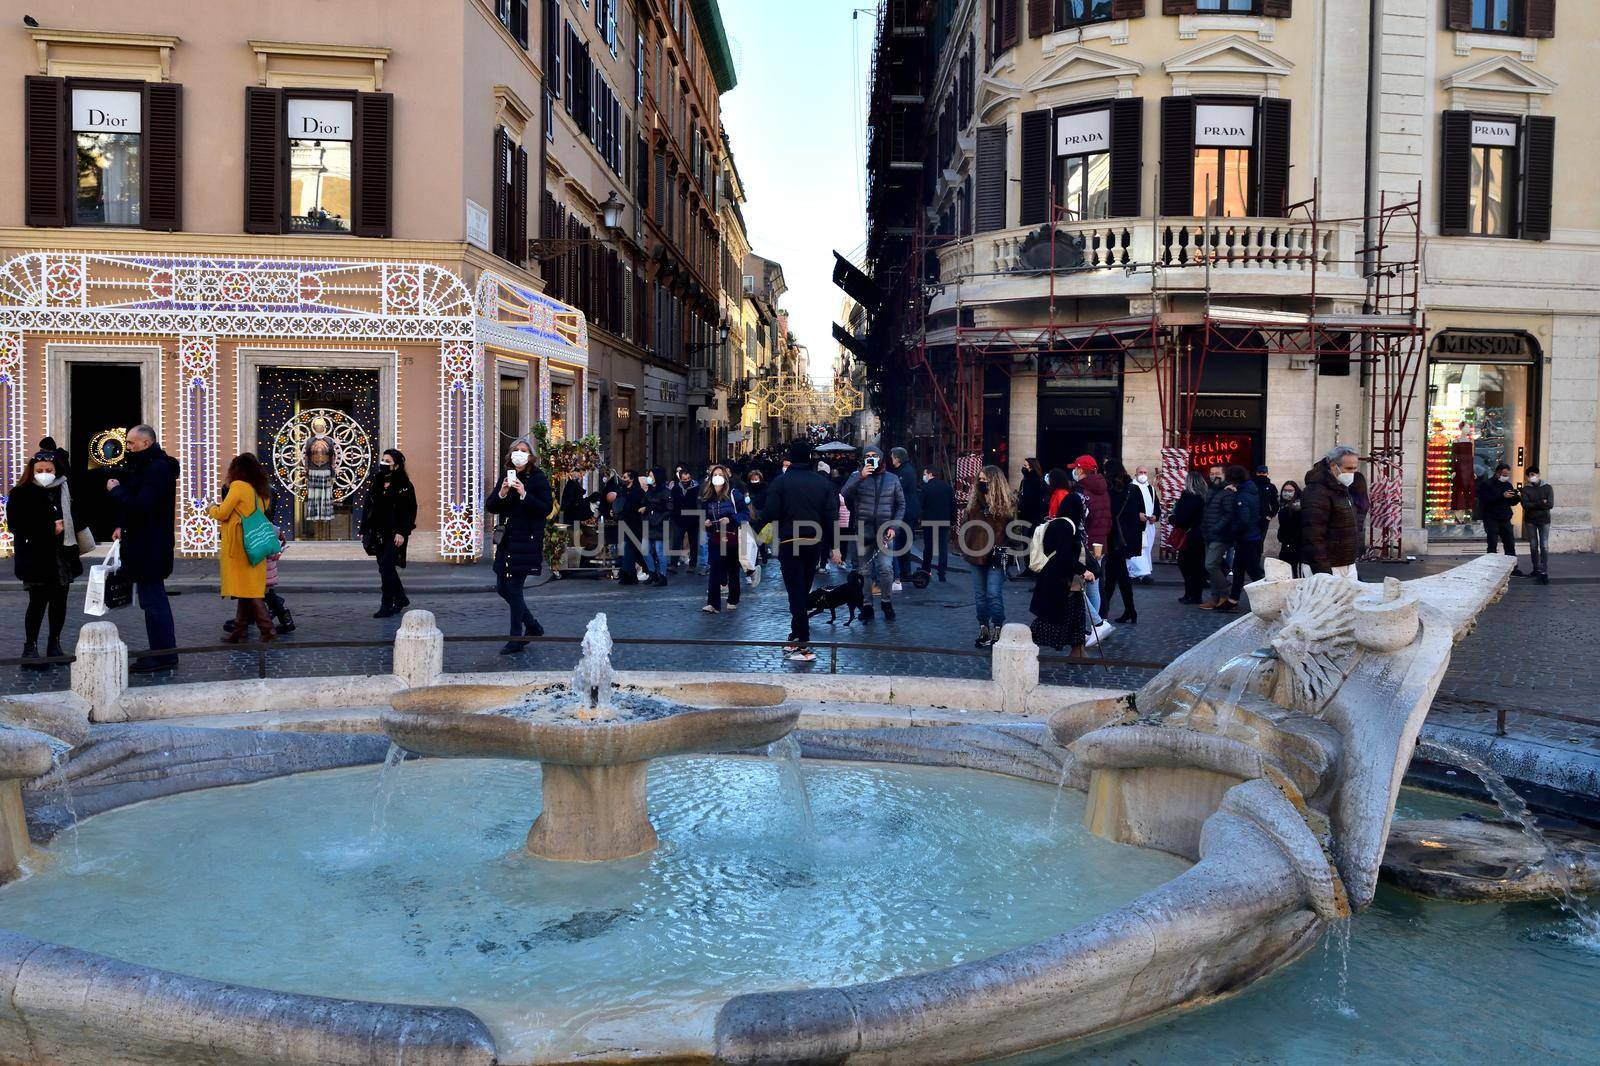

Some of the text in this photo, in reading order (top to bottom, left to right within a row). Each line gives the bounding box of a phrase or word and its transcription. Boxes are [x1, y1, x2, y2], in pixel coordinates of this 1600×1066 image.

[87, 108, 128, 127] Dior
[302, 116, 340, 134] Dior
[1204, 126, 1246, 137] PRADA
[1474, 125, 1511, 136] PRADA
[1064, 131, 1104, 145] PRADA
[1442, 335, 1526, 354] MISSONI
[1194, 408, 1247, 418] MONCLER
[1193, 453, 1233, 467] LUCKY
